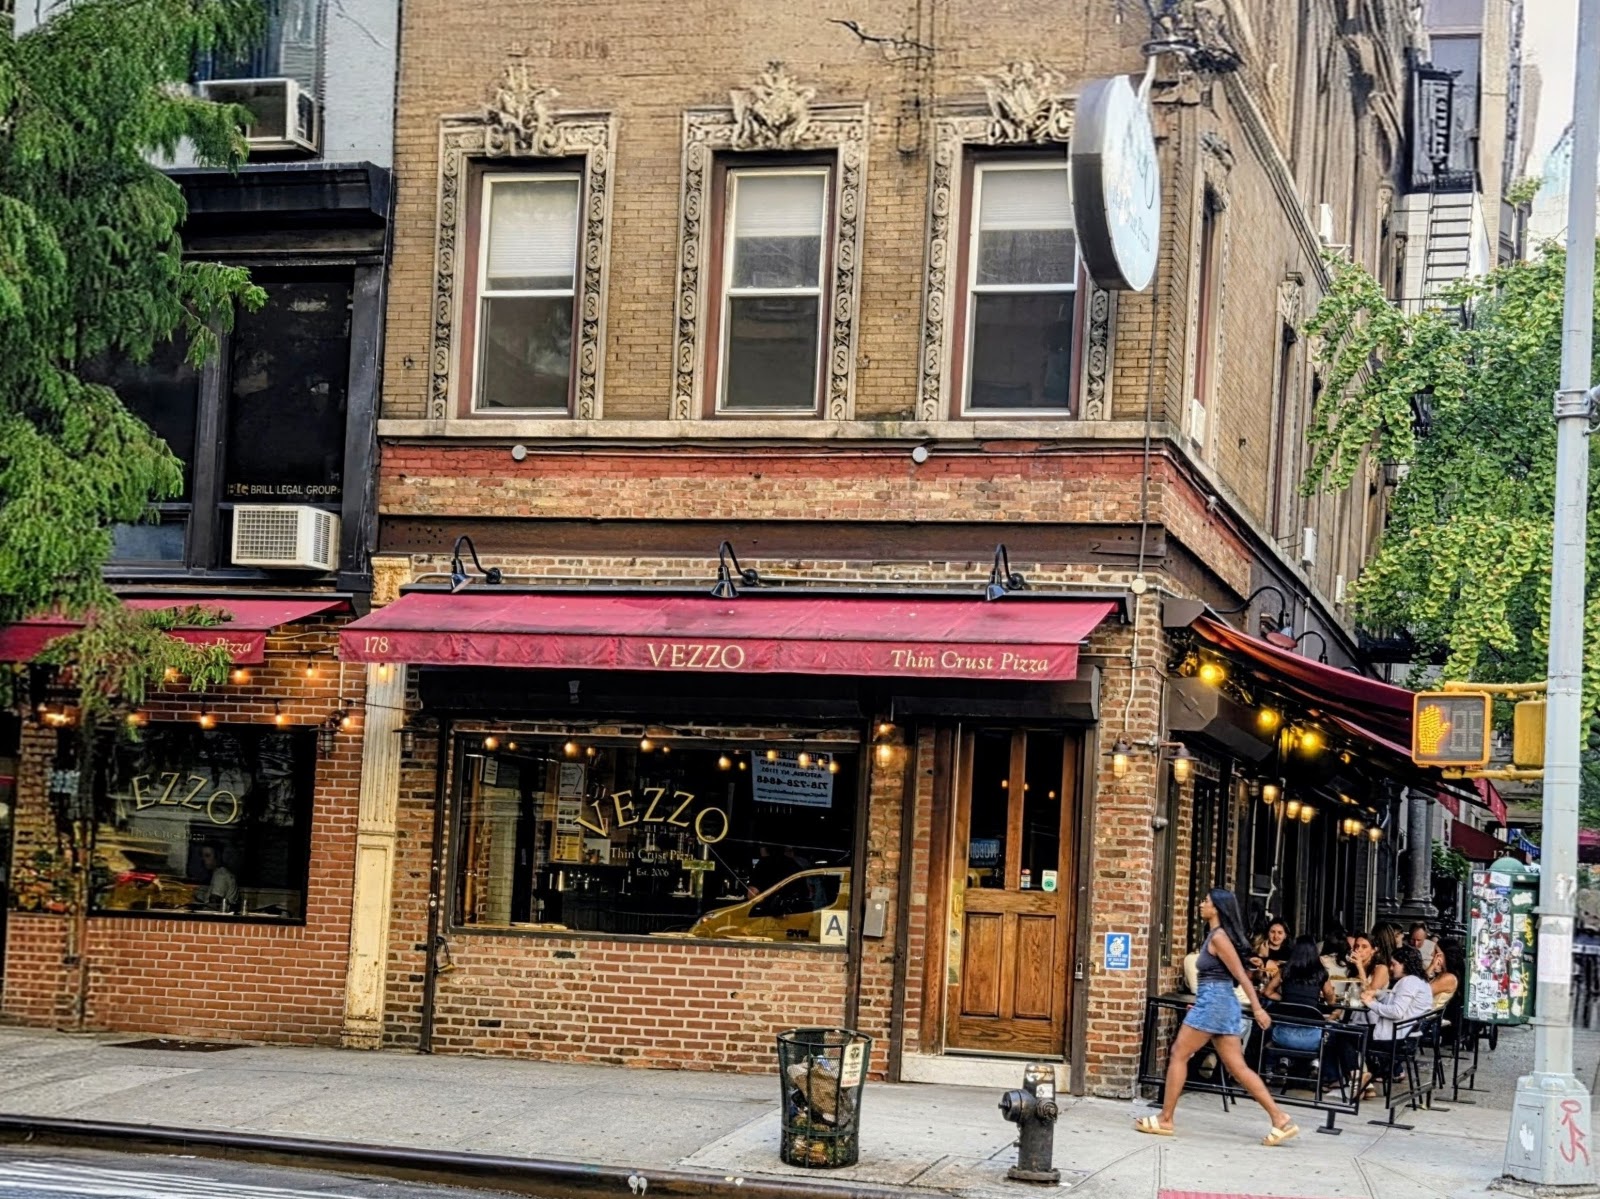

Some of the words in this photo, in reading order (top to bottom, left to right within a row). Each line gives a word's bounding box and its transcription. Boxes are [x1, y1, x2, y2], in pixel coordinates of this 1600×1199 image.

[250, 485, 274, 495] BRILL
[276, 485, 303, 495] LEGAL
[306, 485, 337, 495] GROUP
[364, 636, 389, 653] 178
[647, 643, 745, 669] VEZZO
[891, 650, 935, 668] Thin
[941, 650, 993, 669] Crust
[1000, 652, 1049, 673] Pizza
[573, 787, 729, 843] VEZZO
[610, 847, 635, 859] Thin
[825, 914, 843, 936] A
